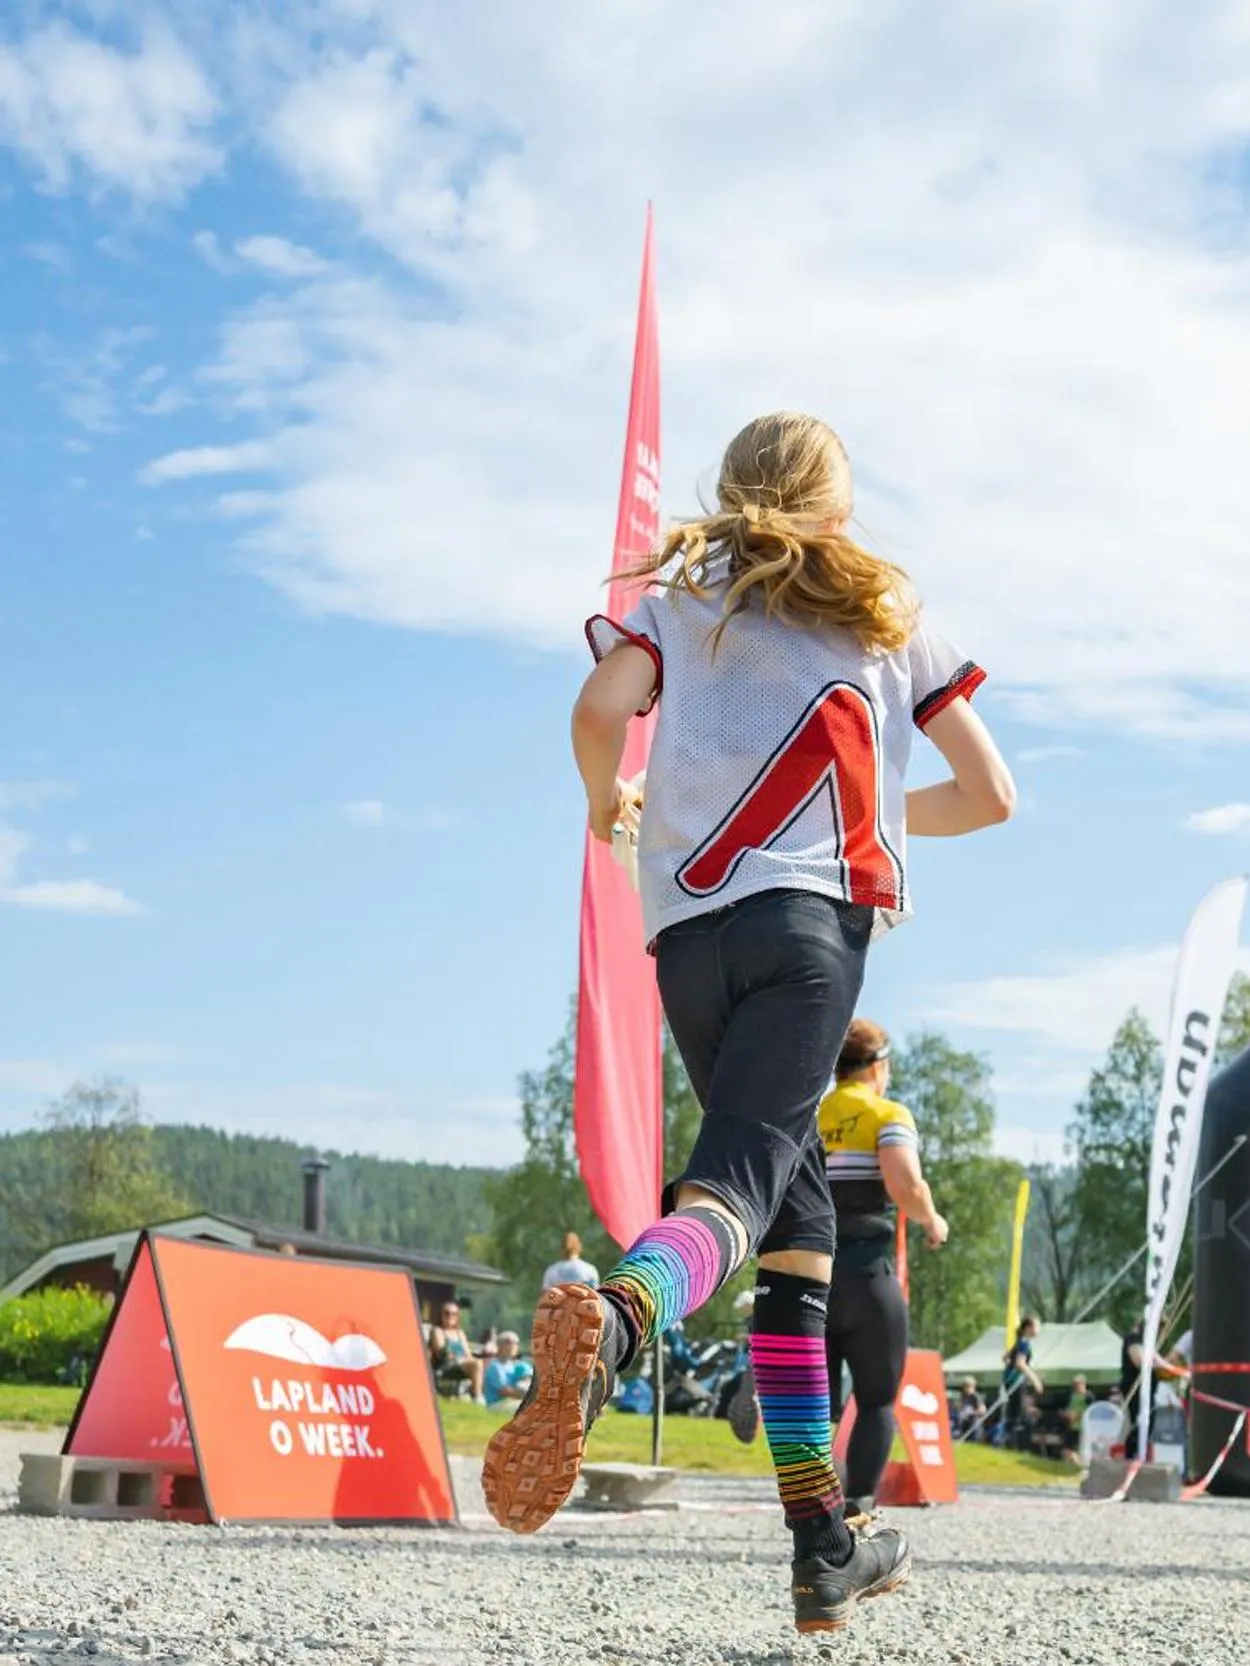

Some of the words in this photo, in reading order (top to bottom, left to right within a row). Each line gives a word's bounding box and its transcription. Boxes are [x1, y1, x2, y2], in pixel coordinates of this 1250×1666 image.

[252, 1376, 375, 1416] LAPLAND
[269, 1418, 293, 1456] O
[297, 1420, 384, 1458] WEEK.
